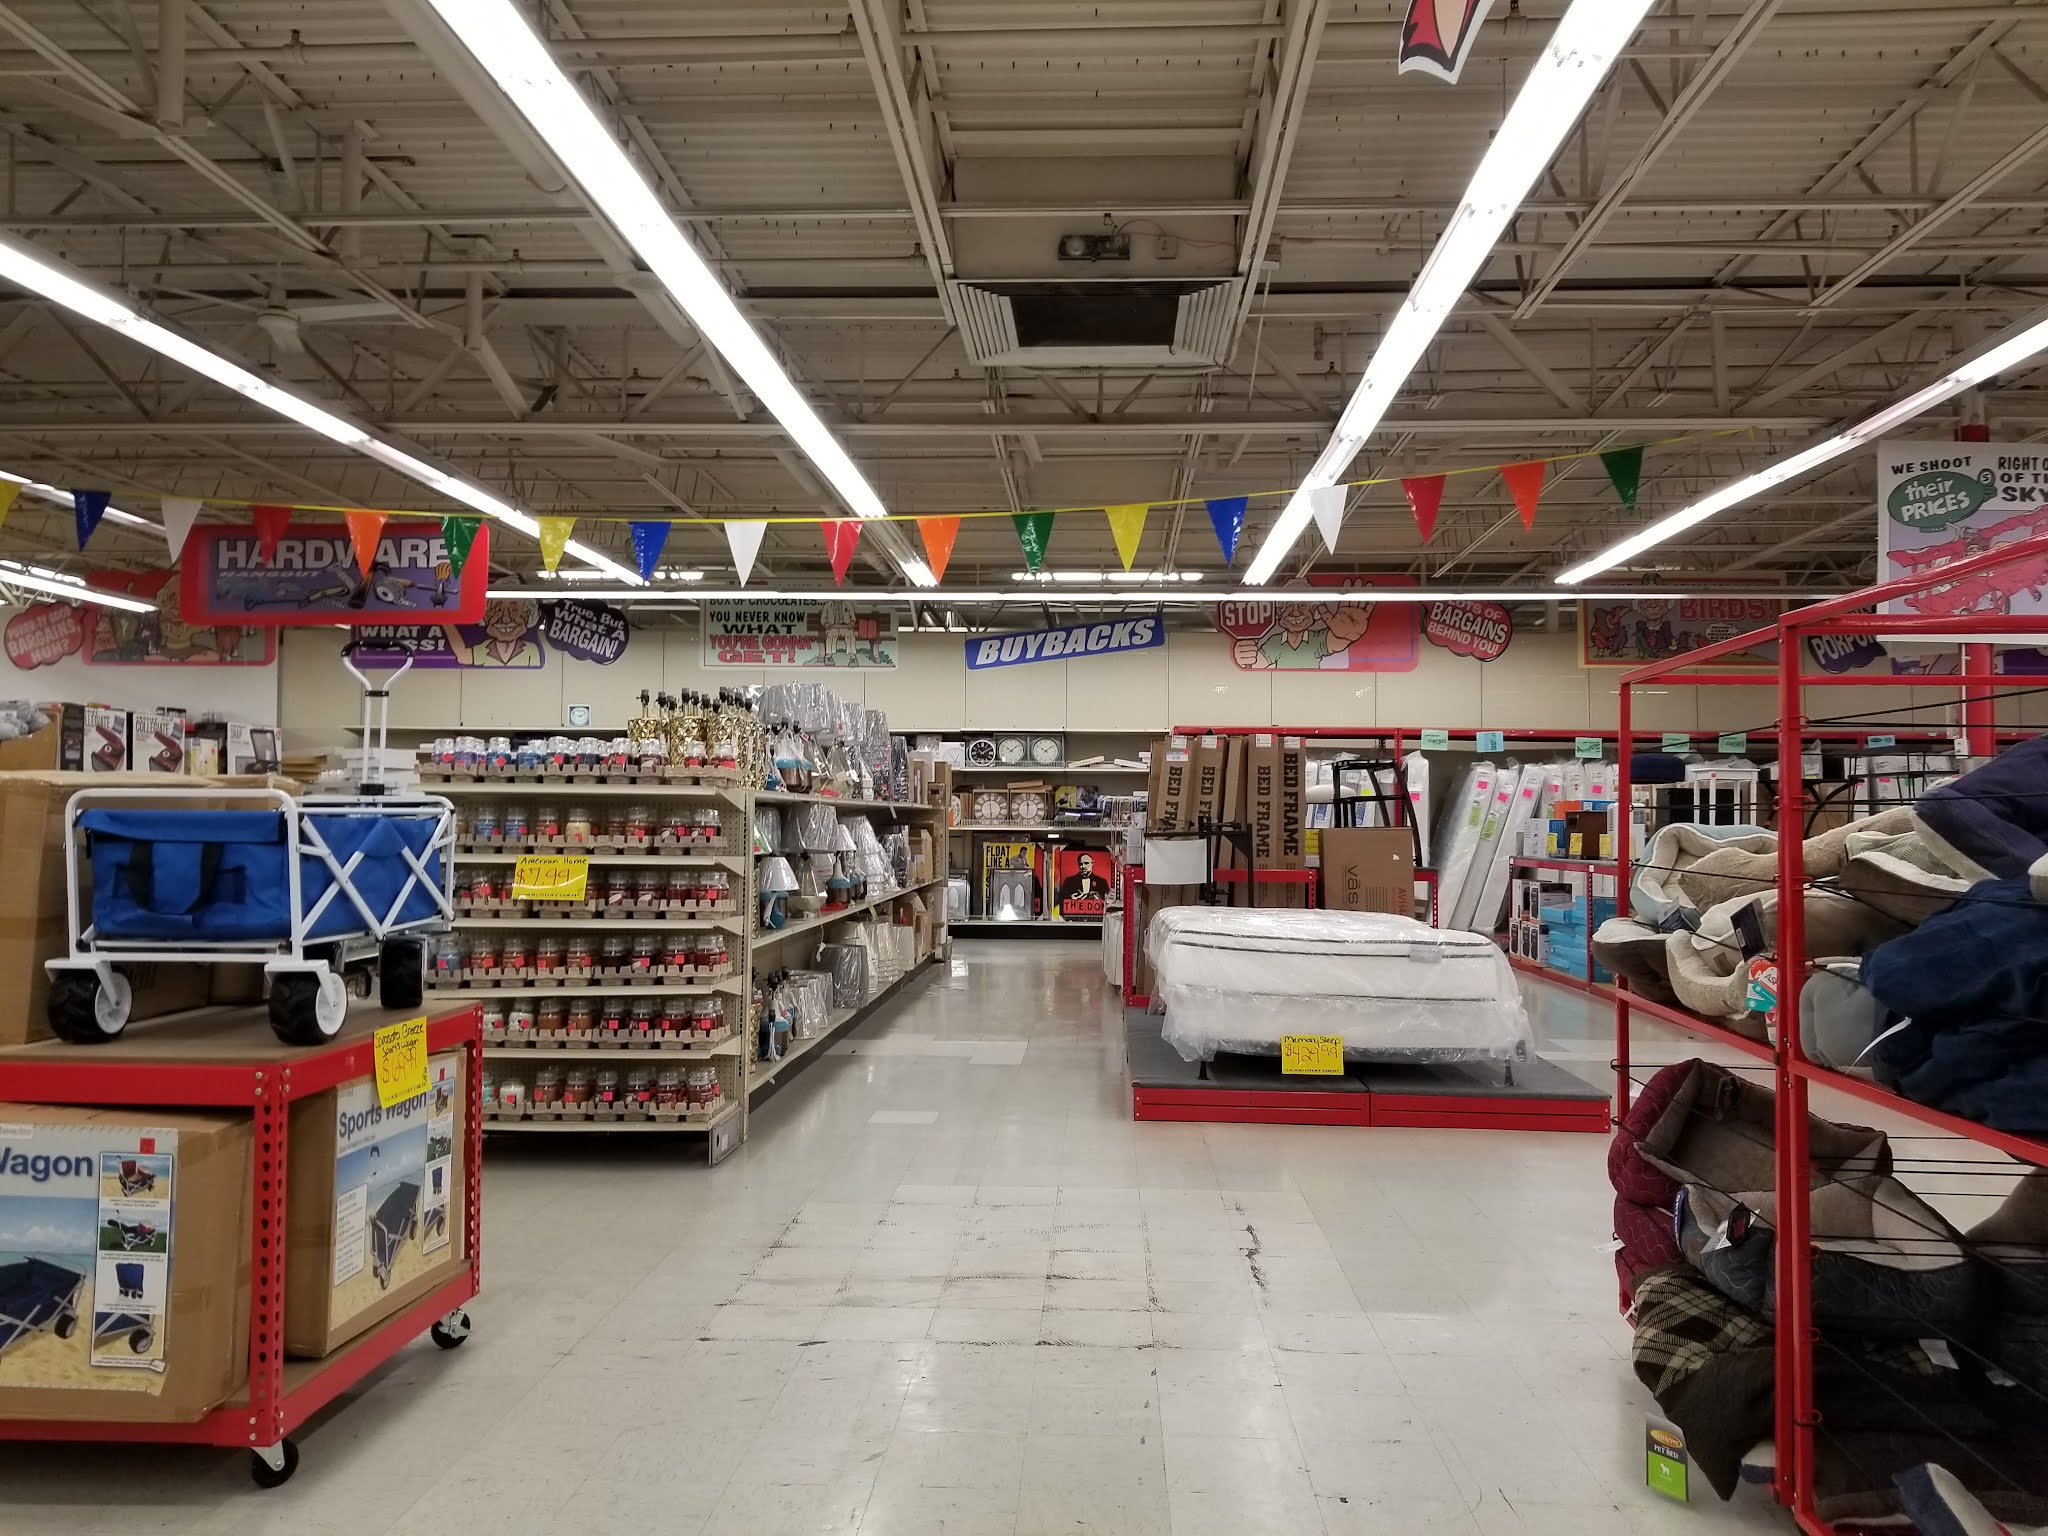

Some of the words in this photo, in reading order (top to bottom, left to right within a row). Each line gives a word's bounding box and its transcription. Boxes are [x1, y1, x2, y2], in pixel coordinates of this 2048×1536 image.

[1892, 463, 1915, 475] WE
[1920, 456, 1972, 472] SHOOT
[1998, 456, 2040, 470] RIGHT
[1905, 477, 1954, 501] their
[2000, 472, 2025, 484] OF
[1901, 491, 1970, 522] PRICES
[564, 600, 597, 622] True,
[600, 613, 624, 630] But
[709, 611, 730, 622] YOU
[735, 611, 769, 622] NEVER
[774, 611, 805, 622] KNOW
[1225, 601, 1271, 626] STOP
[1430, 601, 1507, 644] BARGAINS
[1484, 608, 1502, 620] OF
[1679, 599, 1776, 621] BIRDS!
[360, 625, 421, 638] WHAT
[427, 625, 443, 638] A
[555, 606, 607, 635] What
[611, 629, 625, 642] A
[722, 624, 797, 634] WHAT
[8, 618, 80, 656] BARGAINS,
[549, 619, 619, 659] BARGAIN!
[709, 634, 759, 650] YOU'RE
[975, 620, 1155, 665] BUYBACKS
[1427, 621, 1470, 645] BEHIND
[1472, 636, 1499, 655] YOU!
[717, 650, 796, 663] GET!
[1167, 766, 1183, 796] BED
[1201, 766, 1215, 795] BED
[1257, 766, 1271, 796] BED
[1283, 753, 1298, 788] BED
[1256, 801, 1270, 858] FRAME
[1283, 791, 1298, 856] FRAME
[986, 846, 1010, 857] FLOAT
[986, 857, 1002, 868] LIKE
[1005, 857, 1010, 868] A
[1064, 901, 1083, 910] THE
[1284, 1035, 1319, 1048] Memory
[339, 1103, 382, 1140] Sports
